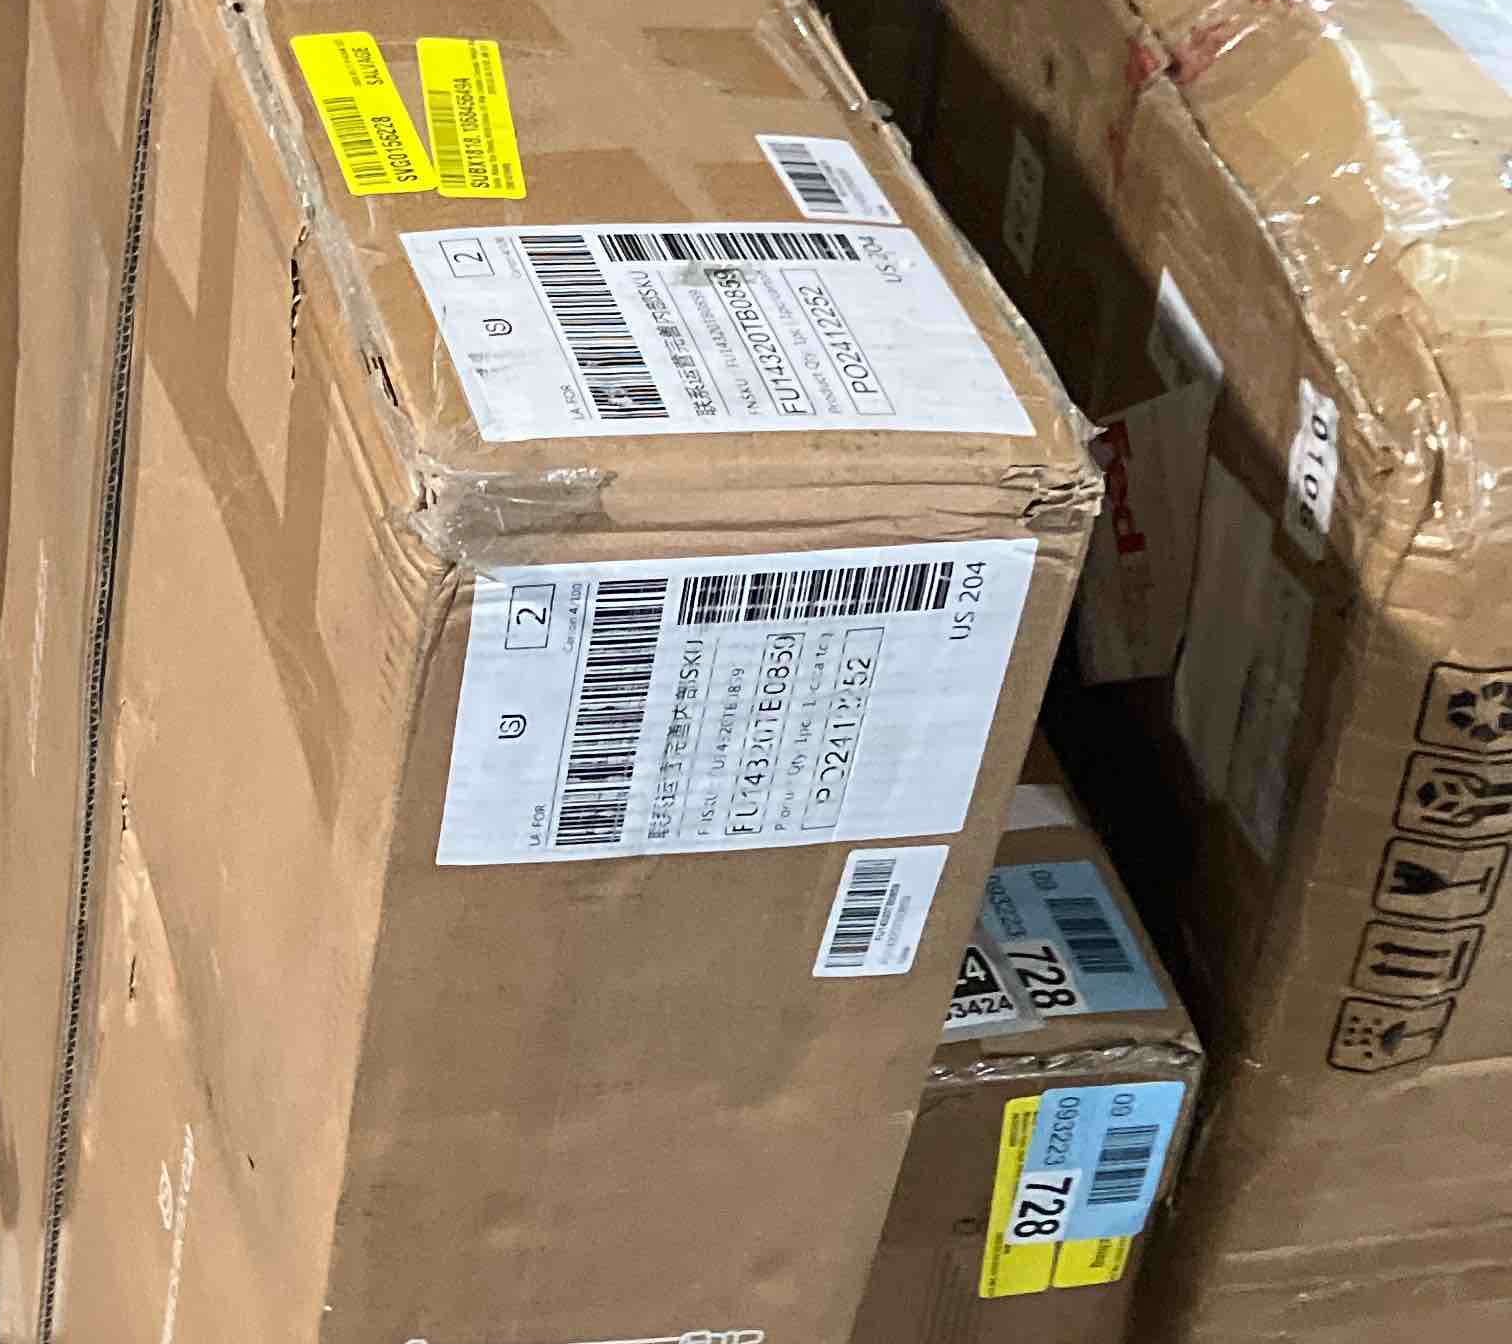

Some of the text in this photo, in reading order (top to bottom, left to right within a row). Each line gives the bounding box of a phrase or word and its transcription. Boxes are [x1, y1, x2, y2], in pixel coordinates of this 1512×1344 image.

[358, 46, 387, 87] SALVAGE
[451, 251, 483, 263] 2
[708, 269, 813, 414] FU14320TB0859
[793, 285, 884, 394] PO2412252
[513, 605, 548, 627] 2
[947, 559, 990, 641] US 204
[1018, 947, 1077, 1010] 728
[1048, 1096, 1081, 1168] 093223
[1013, 1175, 1072, 1239] 728
